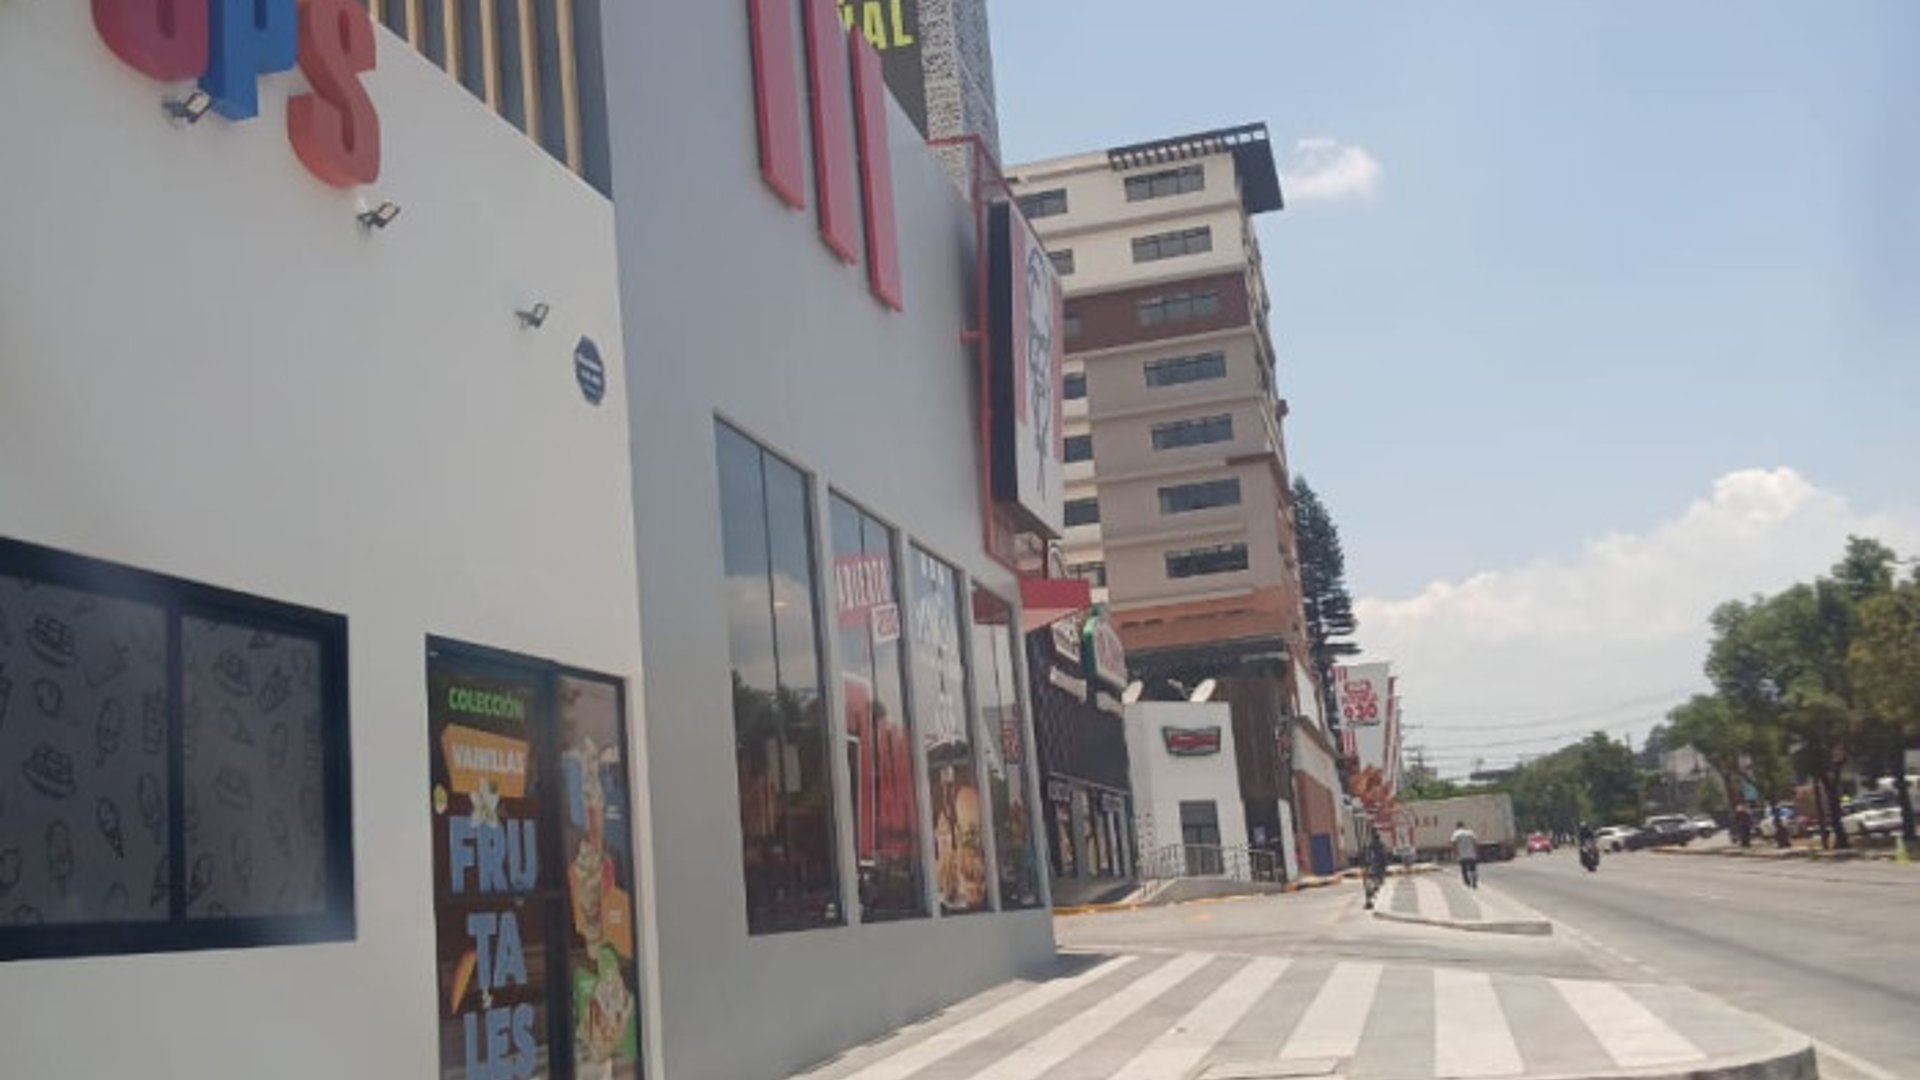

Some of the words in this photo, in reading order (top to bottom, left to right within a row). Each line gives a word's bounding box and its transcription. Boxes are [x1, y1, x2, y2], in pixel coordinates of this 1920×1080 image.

[449, 687, 525, 719] COLECCIÓN
[449, 815, 538, 894] FRU
[467, 912, 527, 990] TA
[464, 1002, 536, 1080] LES
